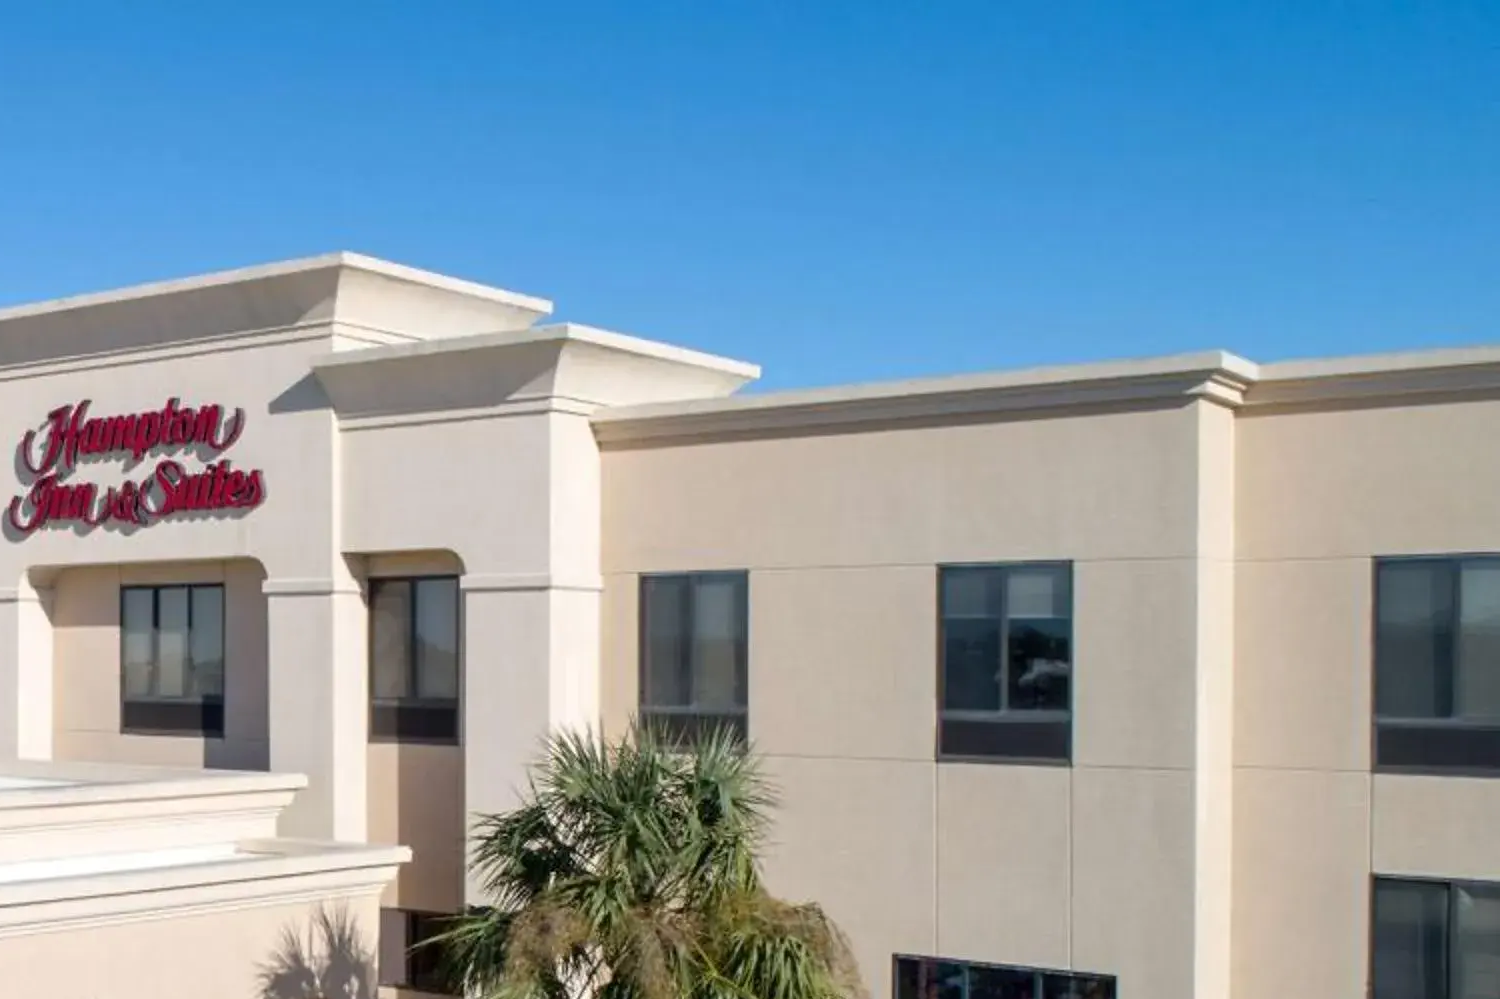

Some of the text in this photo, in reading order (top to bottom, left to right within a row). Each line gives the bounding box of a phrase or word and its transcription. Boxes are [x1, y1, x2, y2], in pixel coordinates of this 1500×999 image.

[22, 398, 244, 475] Hampton
[10, 471, 110, 531] Inn
[140, 459, 264, 516] Suites
